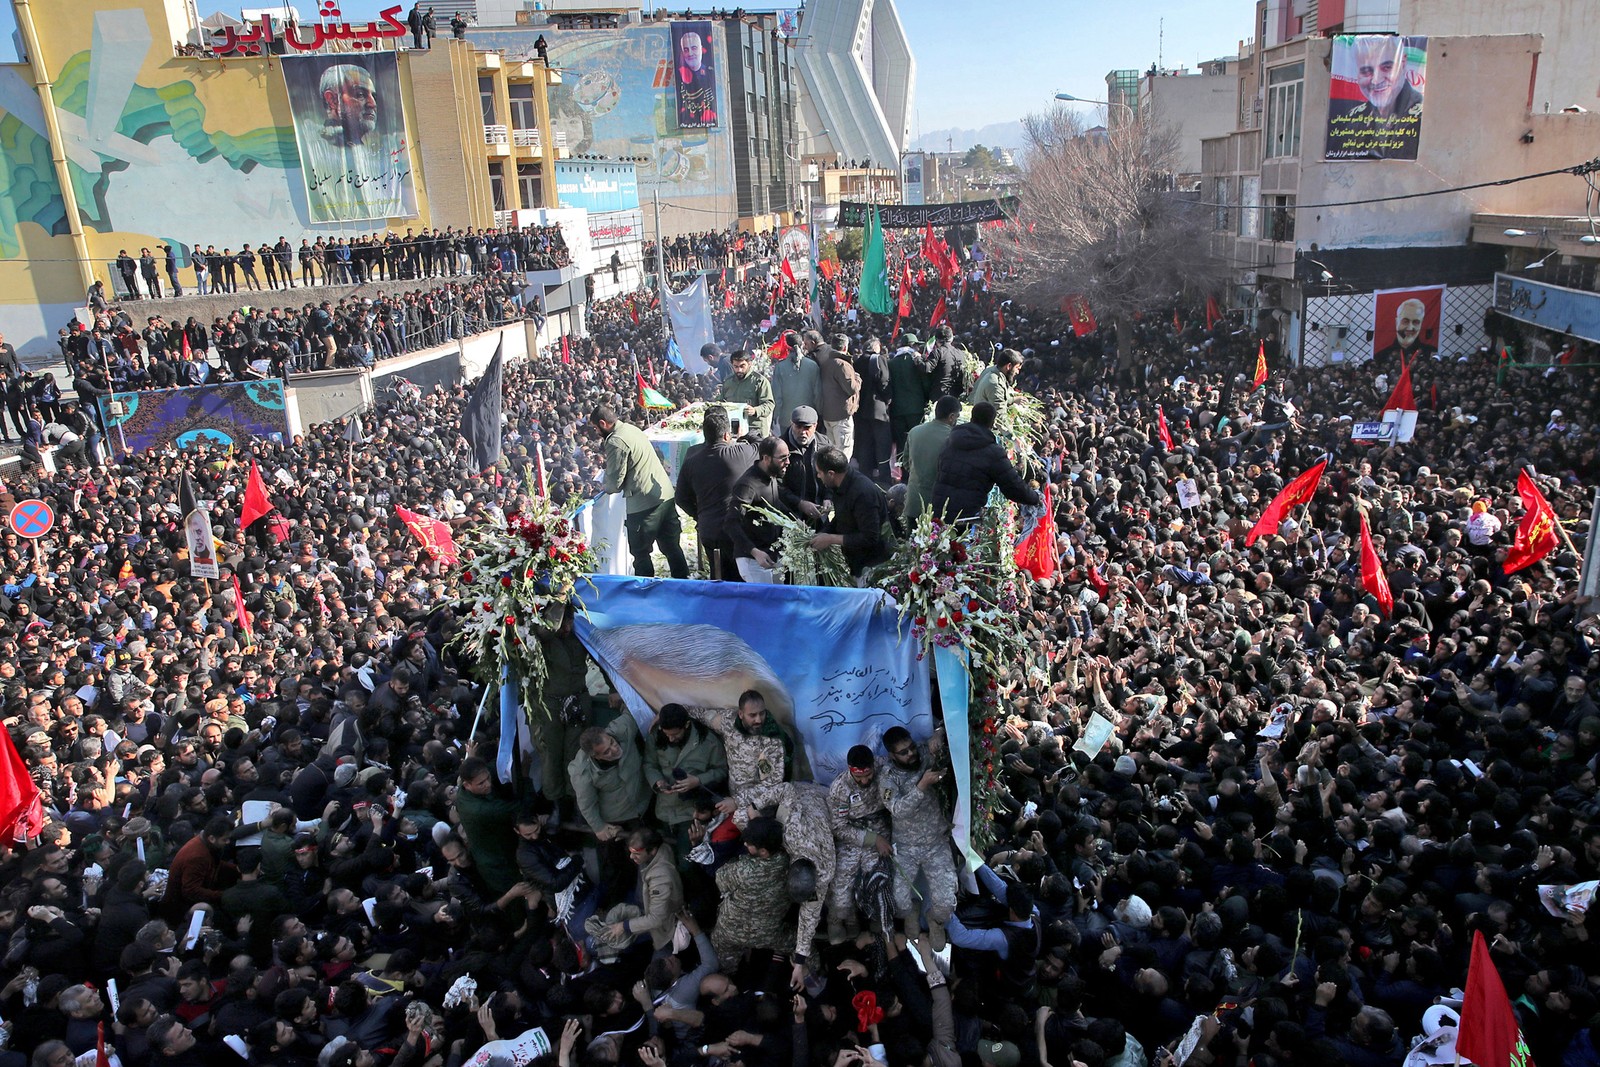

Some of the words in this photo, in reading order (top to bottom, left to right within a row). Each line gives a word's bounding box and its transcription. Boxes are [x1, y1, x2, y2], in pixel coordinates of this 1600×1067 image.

[285, 0, 407, 51] کیش
[1331, 115, 1351, 124] سلیمانی
[1351, 115, 1363, 123] قاسم
[1363, 115, 1374, 124] حاج
[1387, 114, 1401, 125] سردار
[1401, 115, 1418, 123] شهادت
[1330, 128, 1354, 137] همشهریان
[1355, 128, 1375, 137] بخصوص
[1376, 129, 1394, 137] هموطنان
[1395, 127, 1405, 136] کلیه
[1411, 128, 1416, 137] را
[1365, 141, 1378, 149] عرض
[1378, 139, 1392, 148] تسلیت
[1392, 140, 1404, 149] عزیز
[390, 168, 411, 182] سردار
[309, 168, 332, 196] سلیمانی
[334, 169, 353, 198] قاسم
[354, 171, 370, 189] حاج
[370, 171, 388, 190] سپهبد
